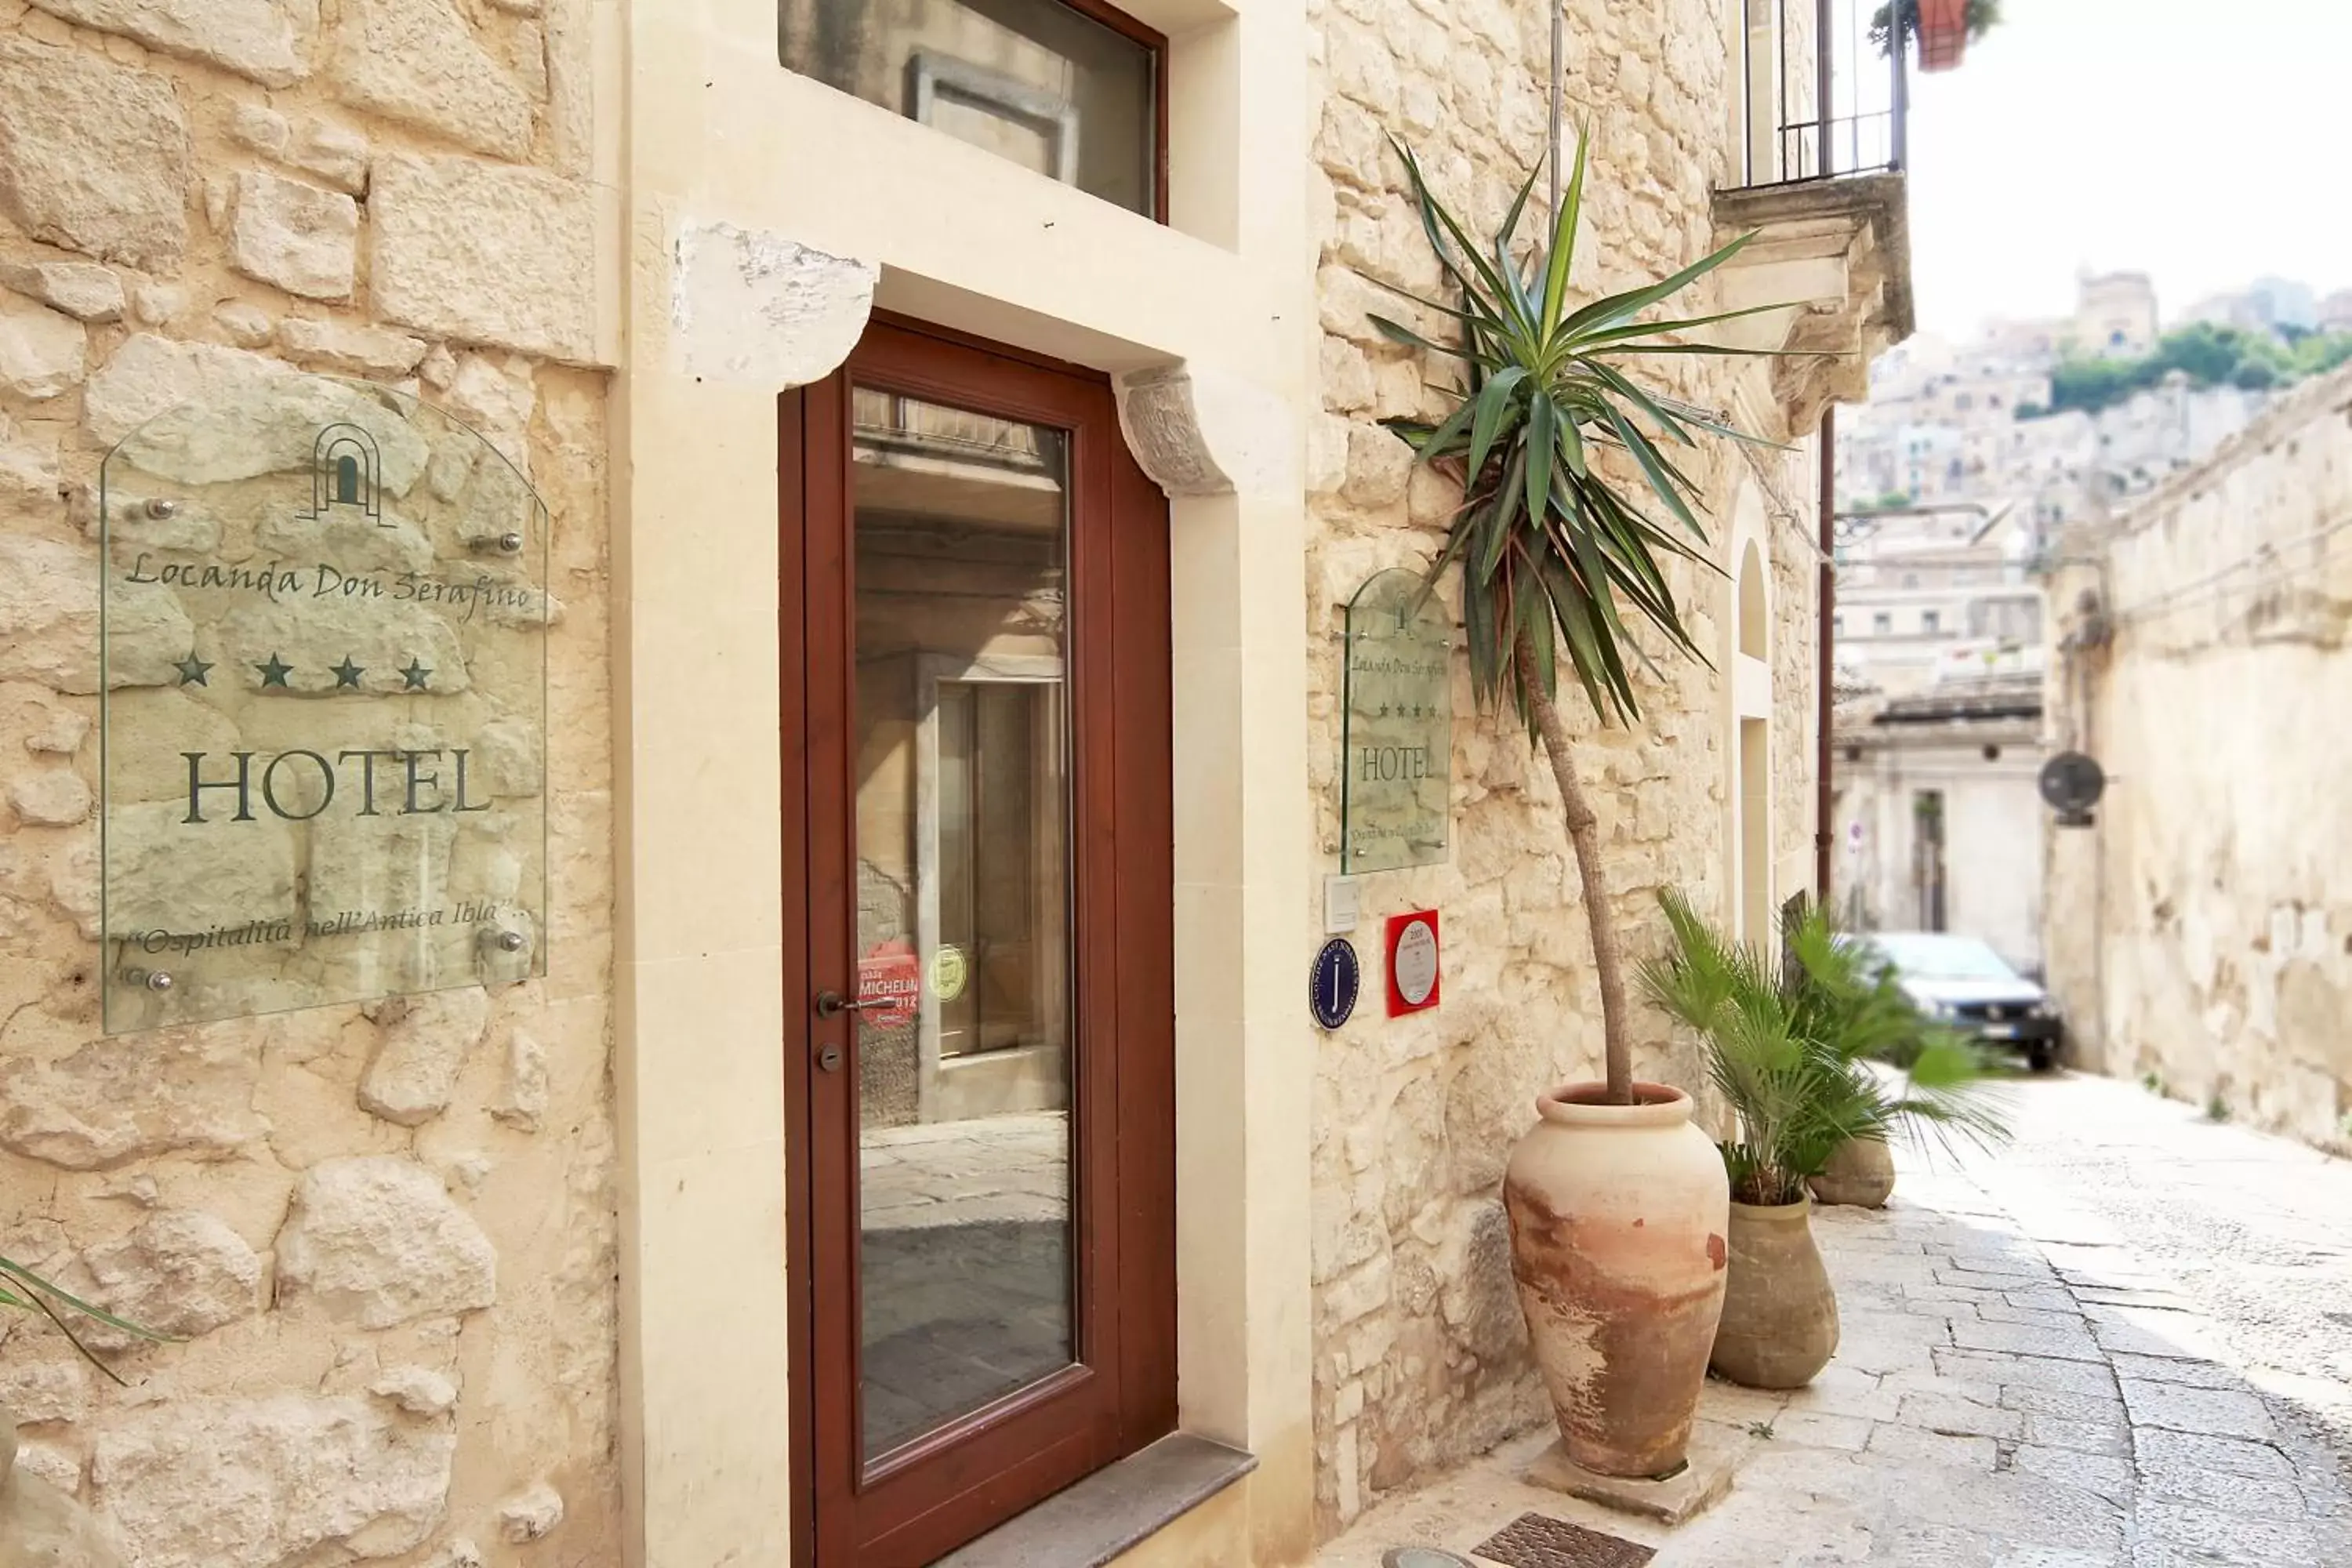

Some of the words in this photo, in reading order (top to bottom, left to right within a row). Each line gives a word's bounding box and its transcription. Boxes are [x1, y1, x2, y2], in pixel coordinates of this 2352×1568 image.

[124, 552, 303, 604] Locanda
[313, 563, 383, 600] Don
[393, 571, 531, 624] Serafino
[180, 749, 493, 824] HOTEL
[1362, 746, 1433, 781] HOTEL
[858, 978, 917, 996] MICHELIN
